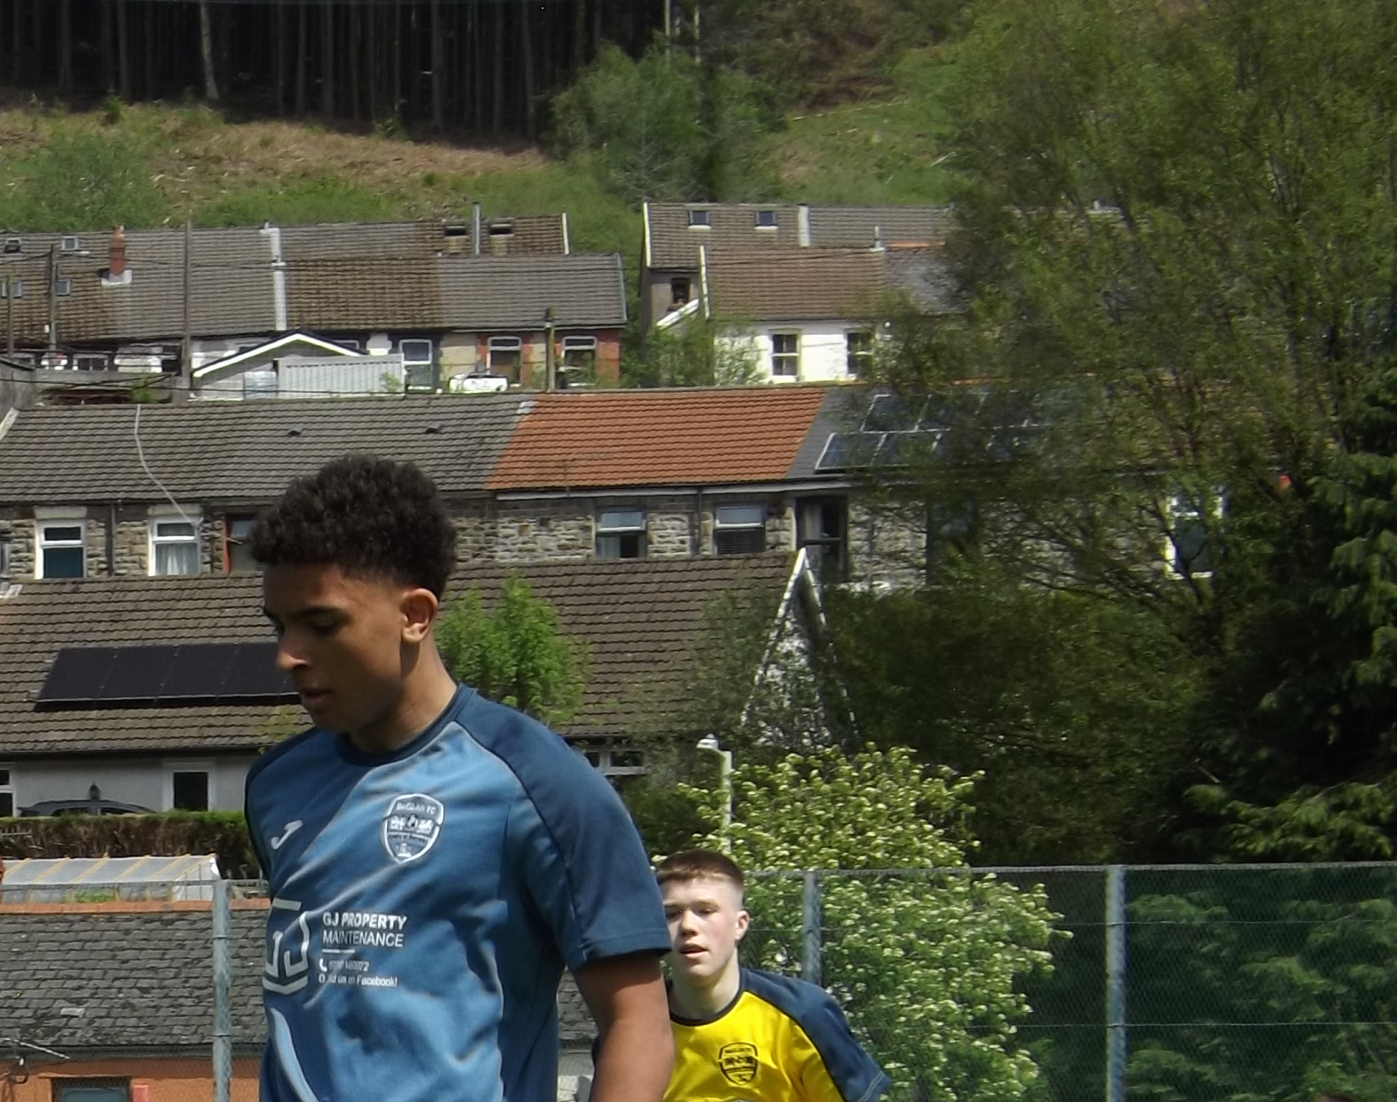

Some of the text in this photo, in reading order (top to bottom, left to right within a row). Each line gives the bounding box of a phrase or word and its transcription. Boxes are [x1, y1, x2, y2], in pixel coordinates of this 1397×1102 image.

[322, 911, 407, 931] GJ PROPERTY
[322, 929, 404, 948] MAINTENANCE
